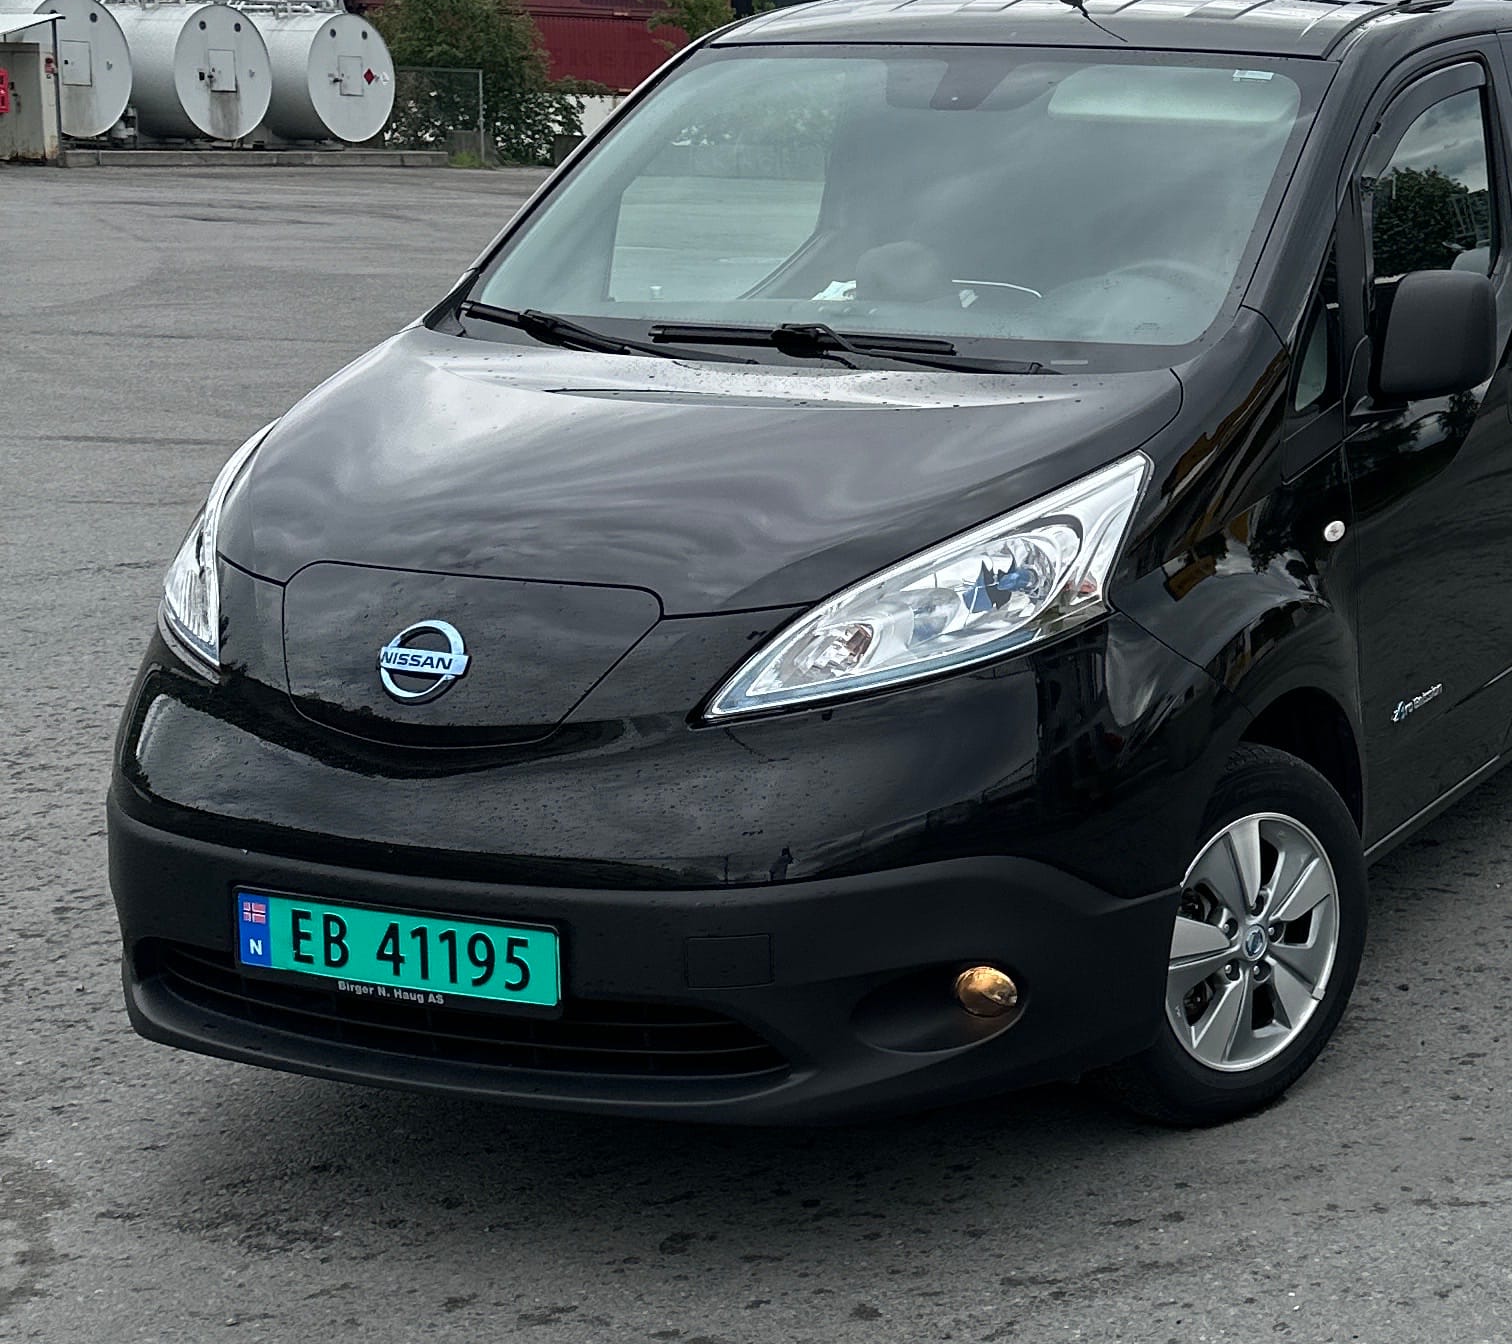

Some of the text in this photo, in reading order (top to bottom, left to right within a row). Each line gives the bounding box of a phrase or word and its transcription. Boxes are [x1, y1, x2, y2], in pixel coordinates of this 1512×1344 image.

[381, 651, 453, 670] NISSAN
[249, 938, 264, 956] N
[291, 908, 531, 992] EB 41195
[338, 980, 445, 1005] Birger N. Haug AS
